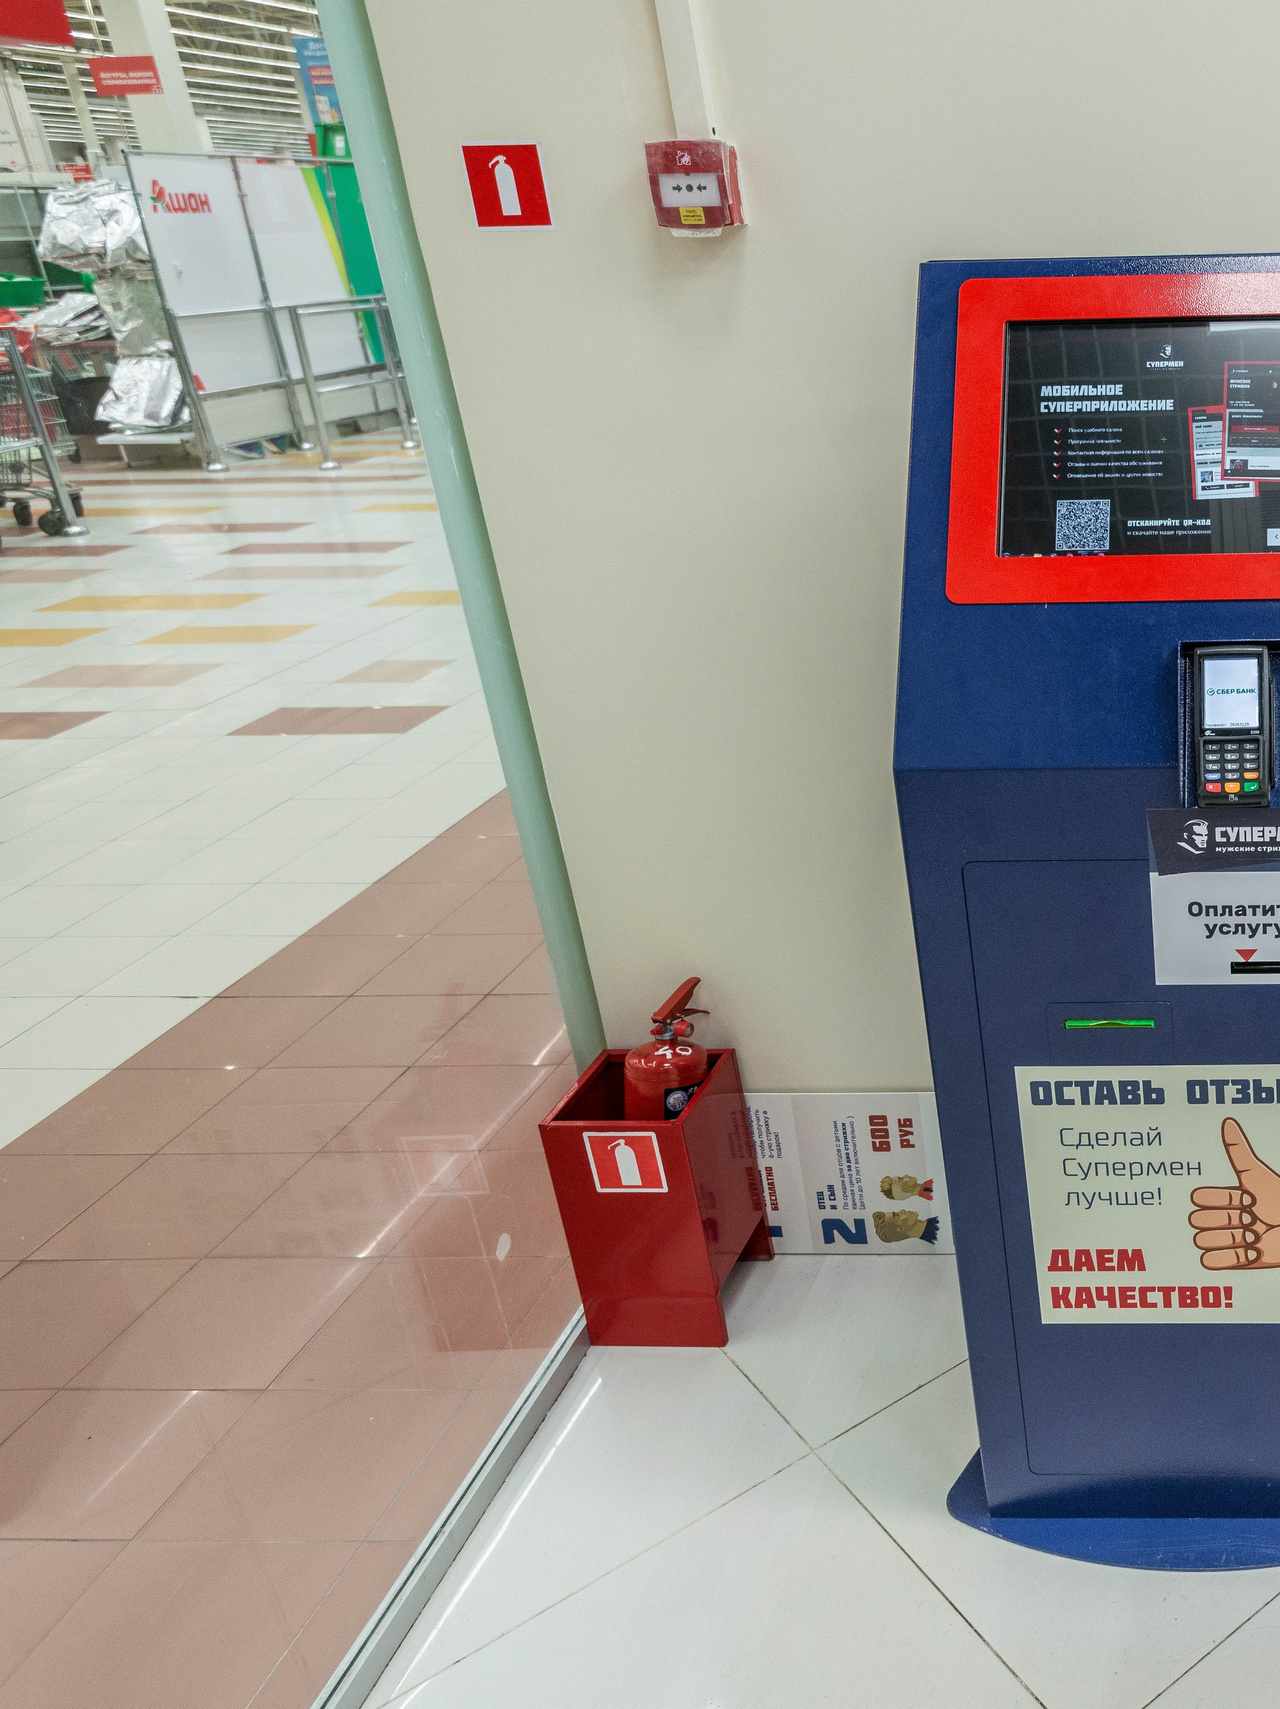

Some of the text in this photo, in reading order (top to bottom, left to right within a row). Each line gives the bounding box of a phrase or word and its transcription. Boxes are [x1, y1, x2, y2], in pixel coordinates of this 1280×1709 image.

[1040, 384, 1123, 396] МОБИЛЬНОЕ
[1040, 399, 1174, 413] СУПЕРПРИЛОЖЕНИЕ
[1127, 518, 1211, 527] ОТСКАНИРУЙТЕ QR-КОД
[1215, 845, 1255, 854] мужские
[1030, 1080, 1165, 1106] ОСТАВЬ
[754, 1109, 764, 1139] получить
[764, 1116, 773, 1141] стрижку
[832, 1120, 841, 1143] детьми
[869, 1115, 891, 1152] 600
[897, 1117, 916, 1149] РУБ
[773, 1131, 783, 1159] подарок!
[850, 1120, 859, 1165] включительно
[1059, 1126, 1163, 1150] Сделай
[836, 1148, 844, 1167] отцов
[840, 1122, 858, 1210] единая цена за две стрижки
[1062, 1157, 1202, 1180] Супермен
[839, 1167, 847, 1179] для
[764, 1166, 780, 1211] БЕСПЛАТНО
[827, 1184, 836, 1201] СЫН
[839, 1179, 849, 1201] средам
[857, 1185, 864, 1193] до
[1064, 1186, 1162, 1210] лучше!
[816, 1191, 826, 1210] ОТЕЦ
[842, 1201, 850, 1210] По
[858, 1193, 866, 1210] (дети
[821, 1218, 868, 1245] 2
[1047, 1248, 1146, 1272] ДАЕМ
[1050, 1286, 1234, 1309] КАЧЕСТВО!
